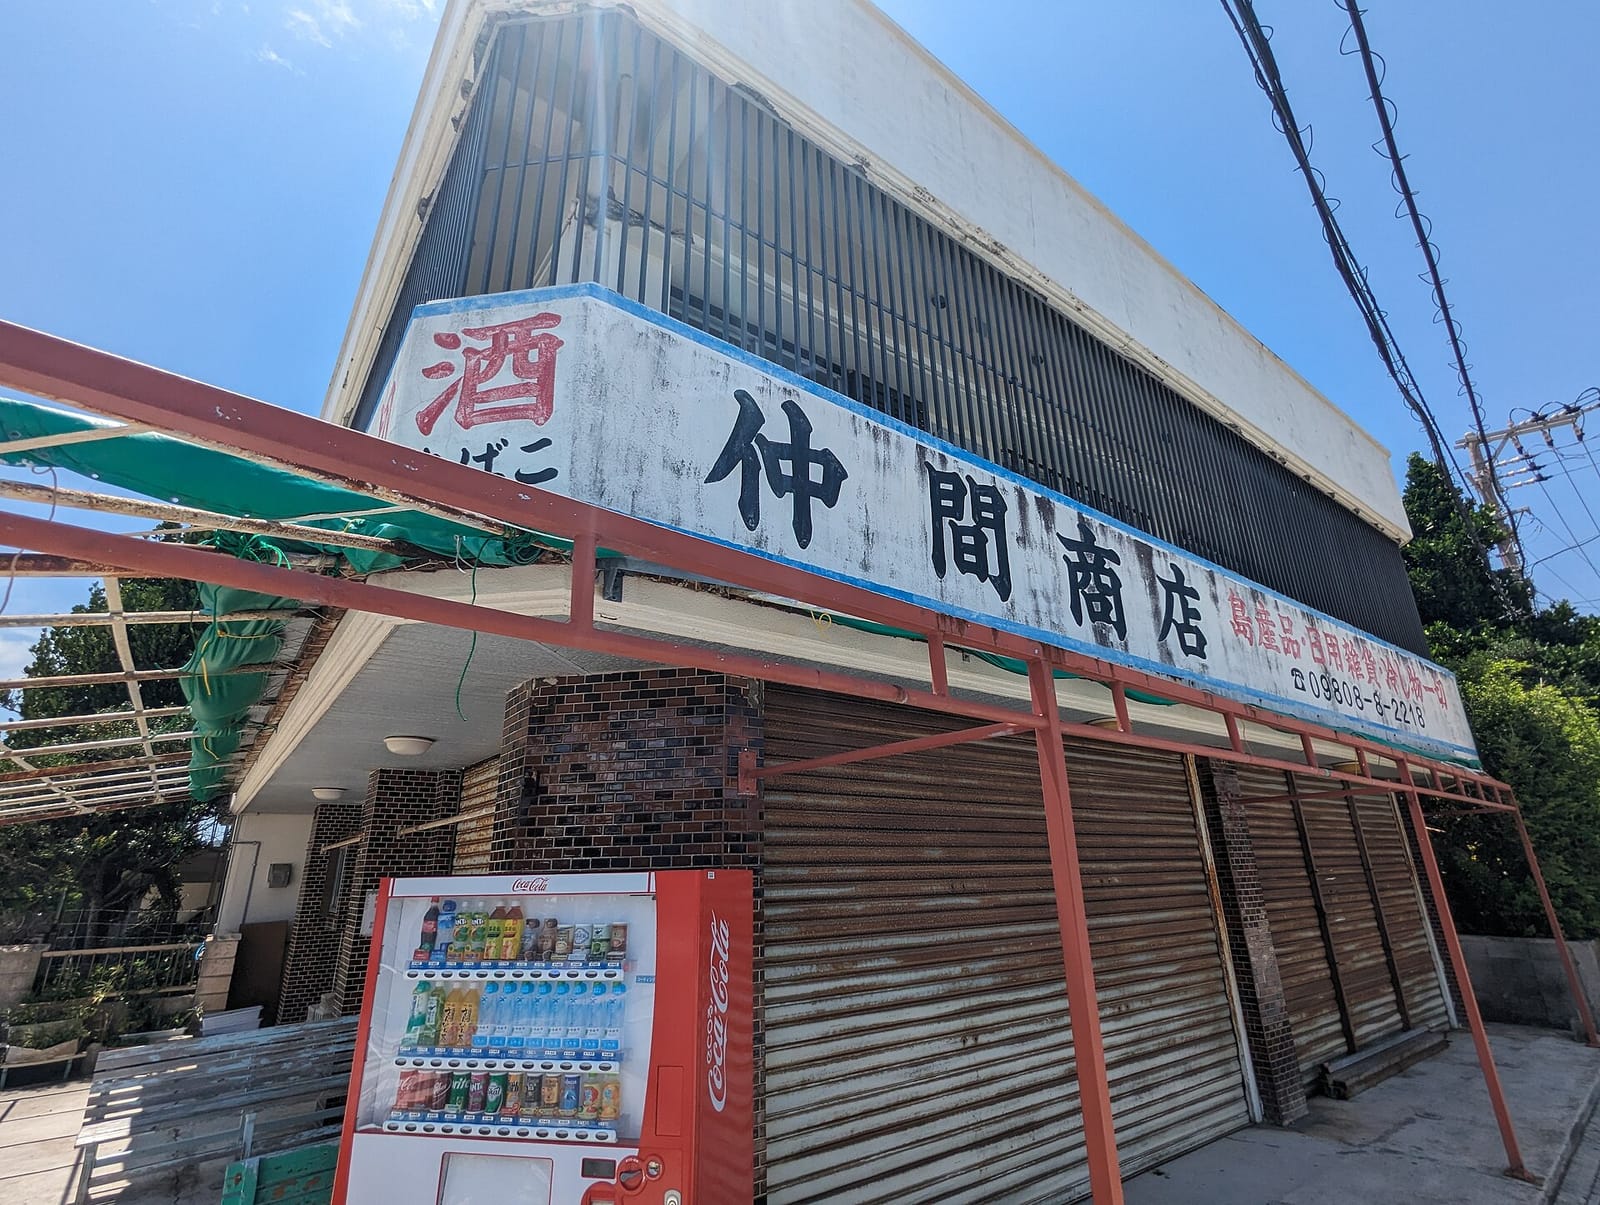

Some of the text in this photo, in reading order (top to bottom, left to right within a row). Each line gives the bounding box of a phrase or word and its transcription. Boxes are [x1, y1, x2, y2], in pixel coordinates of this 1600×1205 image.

[415, 312, 565, 436] 酒
[423, 437, 559, 485] ばこ
[704, 389, 1207, 660] 仲間商店
[1308, 671, 1426, 728] 09808-8-2218
[708, 909, 732, 1112] Coca-Cola
